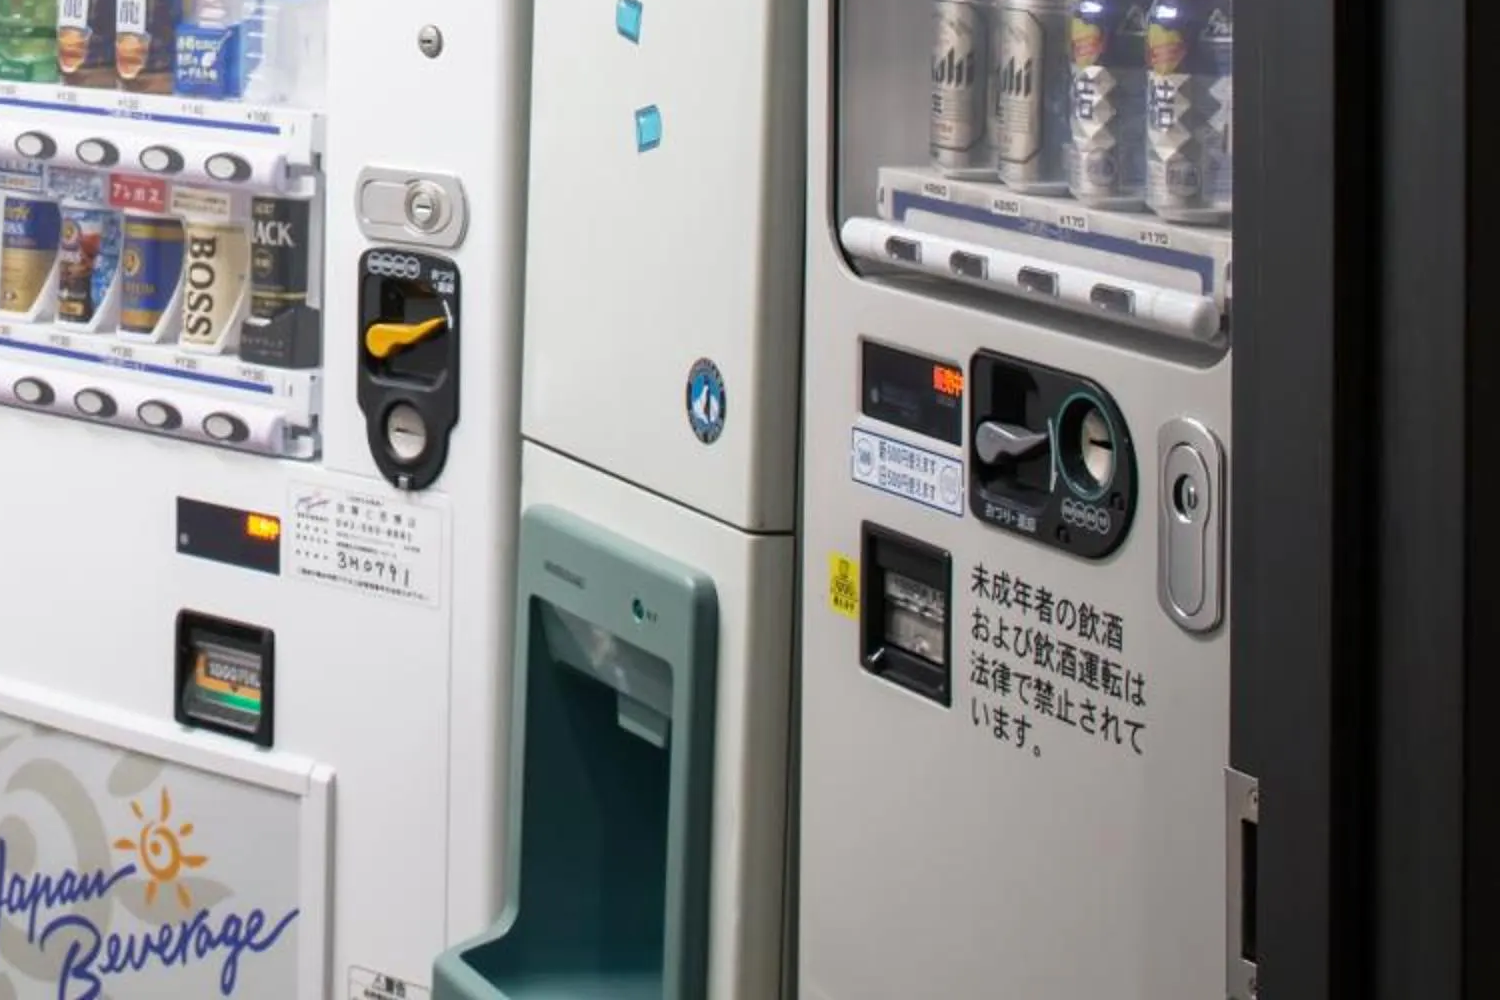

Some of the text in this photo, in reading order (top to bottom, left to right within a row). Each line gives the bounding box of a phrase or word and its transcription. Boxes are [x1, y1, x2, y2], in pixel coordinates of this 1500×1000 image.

[184, 234, 218, 339] BOSS
[971, 564, 1124, 653] 未成年者の飲酒
[970, 650, 1147, 755] 法律で禁止されて
[971, 607, 1147, 707] および飲酒運転は
[971, 698, 1041, 758] います。
[40, 909, 300, 1000] Beverage
